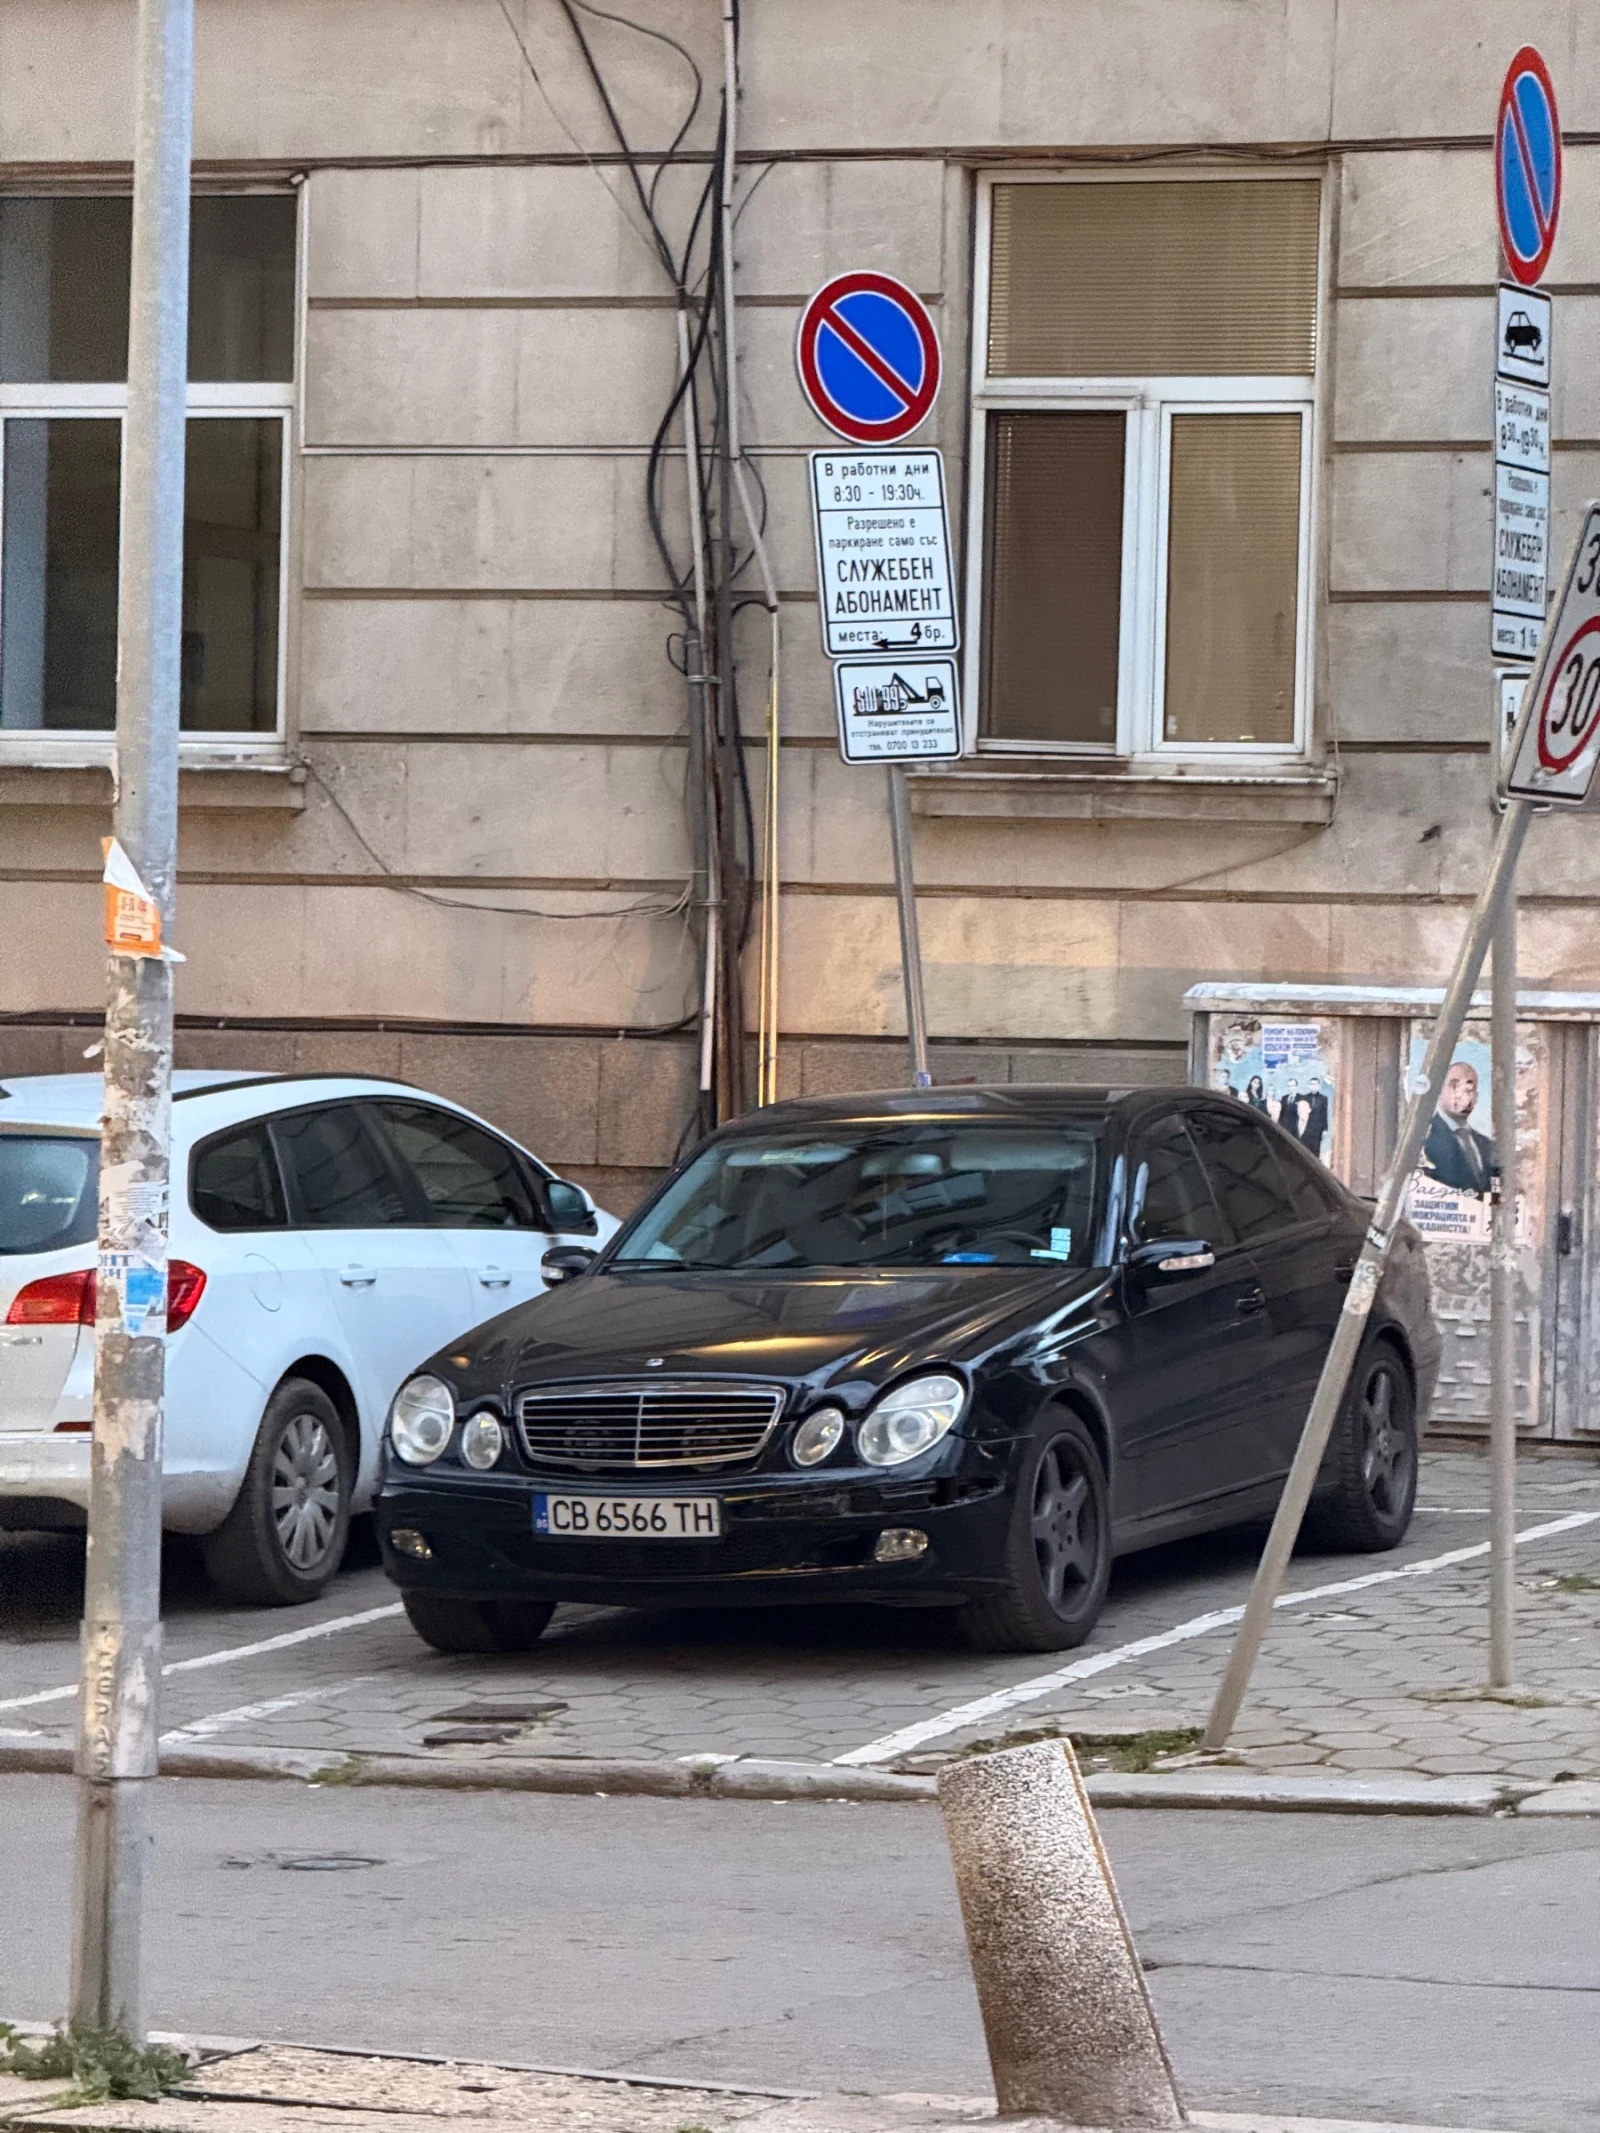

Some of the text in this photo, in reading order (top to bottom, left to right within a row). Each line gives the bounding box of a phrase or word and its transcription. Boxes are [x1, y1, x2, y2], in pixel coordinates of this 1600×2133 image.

[825, 462, 930, 479] В работни дни
[834, 485, 862, 502] 8:30
[847, 516, 916, 532] Разрешено е
[829, 536, 938, 551] паркиране само със
[837, 557, 934, 583] СЛУЖЕБЕН
[835, 587, 942, 614] АБОНАМЕНТ
[910, 622, 921, 640] 4
[924, 625, 945, 642] бр.
[552, 1500, 714, 1533] CB 6566 TH
